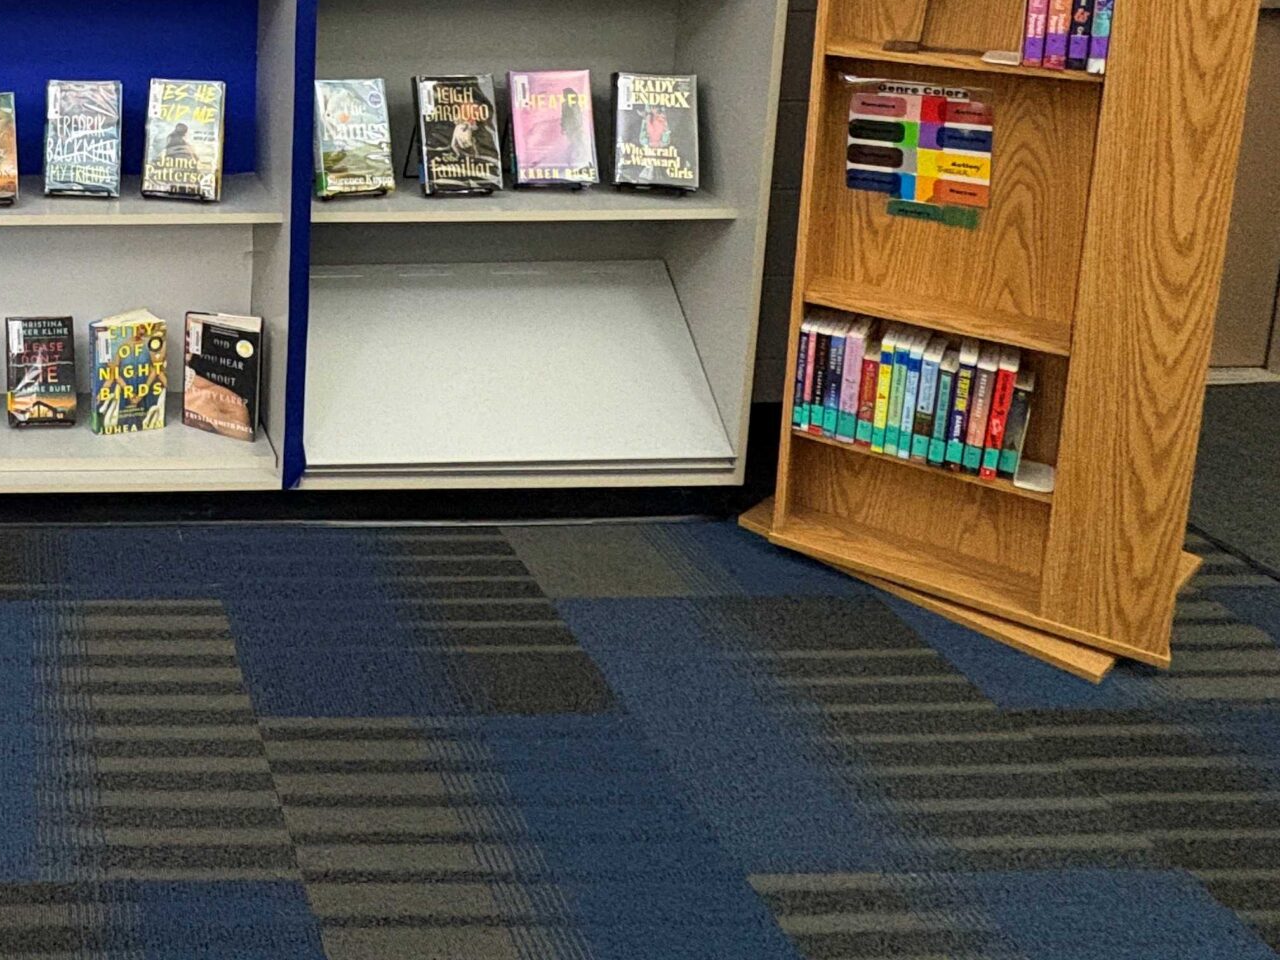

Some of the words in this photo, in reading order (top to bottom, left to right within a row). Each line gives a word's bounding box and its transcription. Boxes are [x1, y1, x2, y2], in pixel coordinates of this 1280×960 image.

[193, 84, 217, 102] HE
[437, 86, 474, 104] LEIGH
[878, 83, 919, 95] Genre
[923, 86, 969, 99] Colors
[191, 106, 216, 125] ME
[56, 114, 107, 137] FREDRIK
[323, 122, 388, 143] Names
[46, 138, 117, 163] BACKMAN
[619, 142, 679, 158] Witchcraft
[49, 164, 66, 183] MY
[69, 163, 112, 184] FRIENDS
[519, 168, 559, 180] KAREN
[666, 167, 694, 180] Girls
[41, 327, 69, 336] KLINE
[107, 322, 155, 341] CITY
[118, 342, 144, 360] OF
[98, 361, 164, 382] NIGHT
[219, 357, 245, 371] HEAR
[48, 384, 72, 394] BURT
[99, 382, 163, 402] BIRDS
